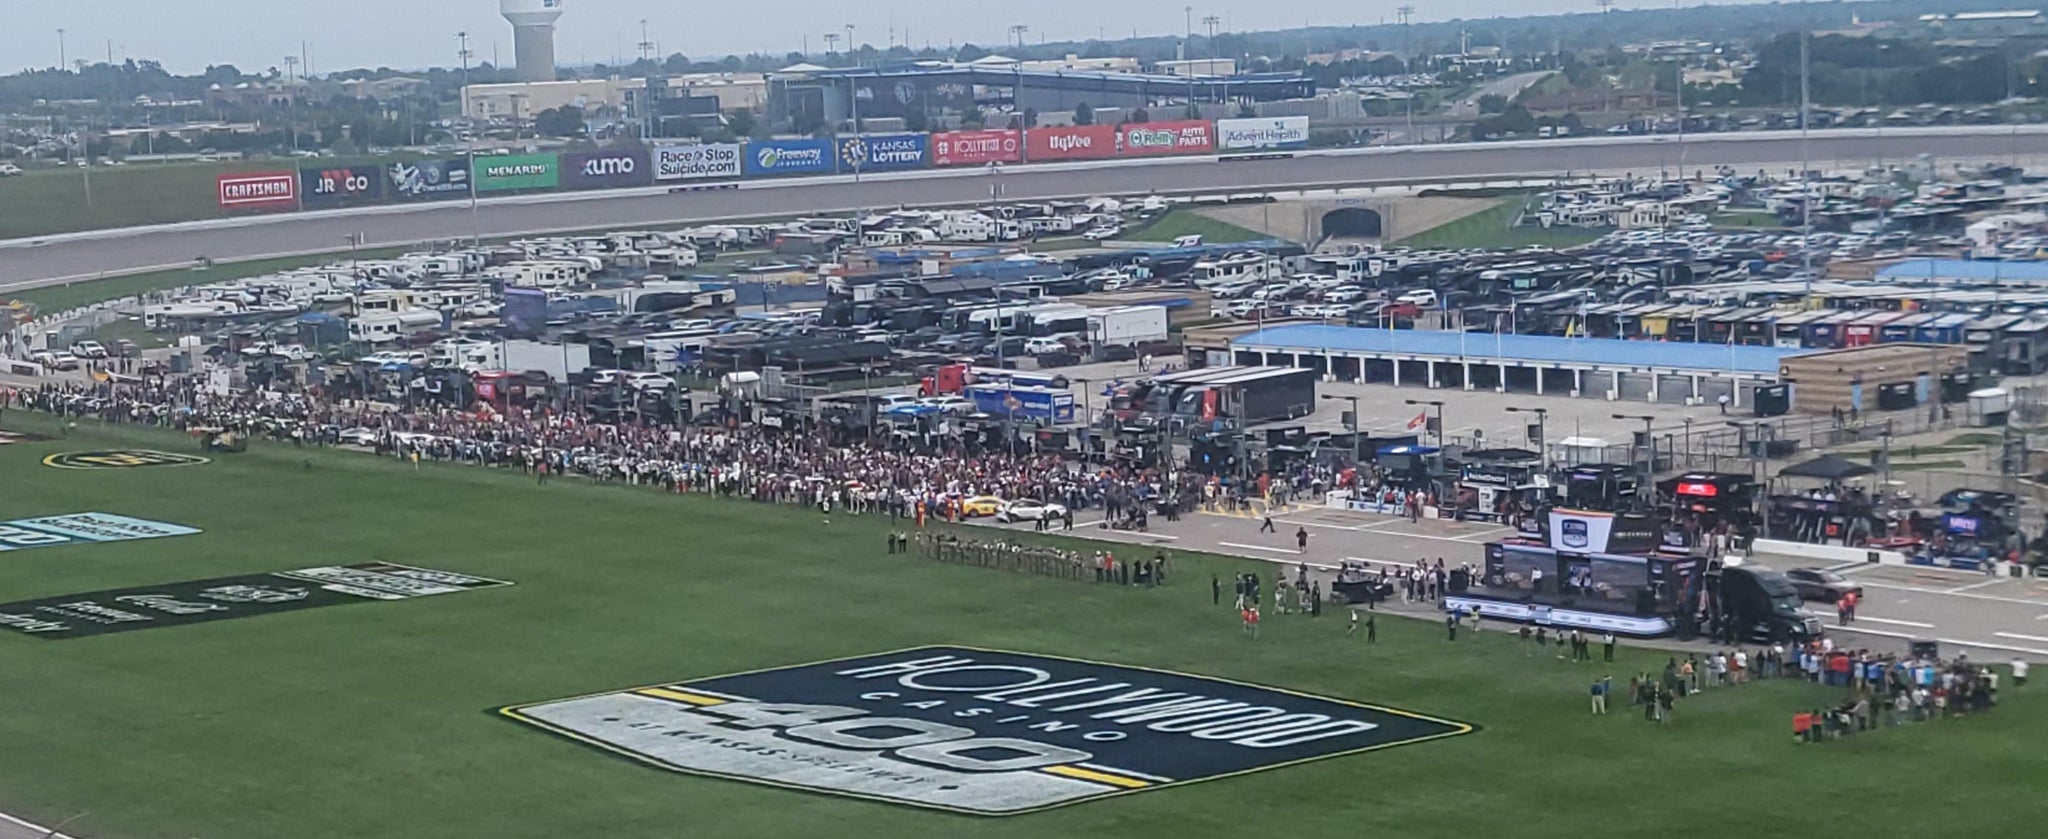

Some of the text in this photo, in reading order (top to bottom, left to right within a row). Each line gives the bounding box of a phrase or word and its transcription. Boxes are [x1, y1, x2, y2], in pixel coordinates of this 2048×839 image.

[1182, 127, 1205, 136] AUTO
[872, 141, 916, 151] KANSAS
[1179, 136, 1208, 146] PARTS
[660, 151, 692, 162] Race
[705, 148, 734, 161] Stop
[776, 148, 821, 160] Freeway
[873, 150, 922, 162] LOTTERY
[487, 164, 546, 177] MENARDS
[660, 162, 736, 175] Suicide.com
[225, 179, 288, 197] CRAFTSMAN
[314, 178, 336, 193] JR
[836, 655, 1379, 748] HOLLYWOOD
[861, 690, 1129, 742] CASINO
[627, 722, 664, 731] AT
[661, 730, 787, 756] KANSAS
[690, 702, 1094, 773] 400
